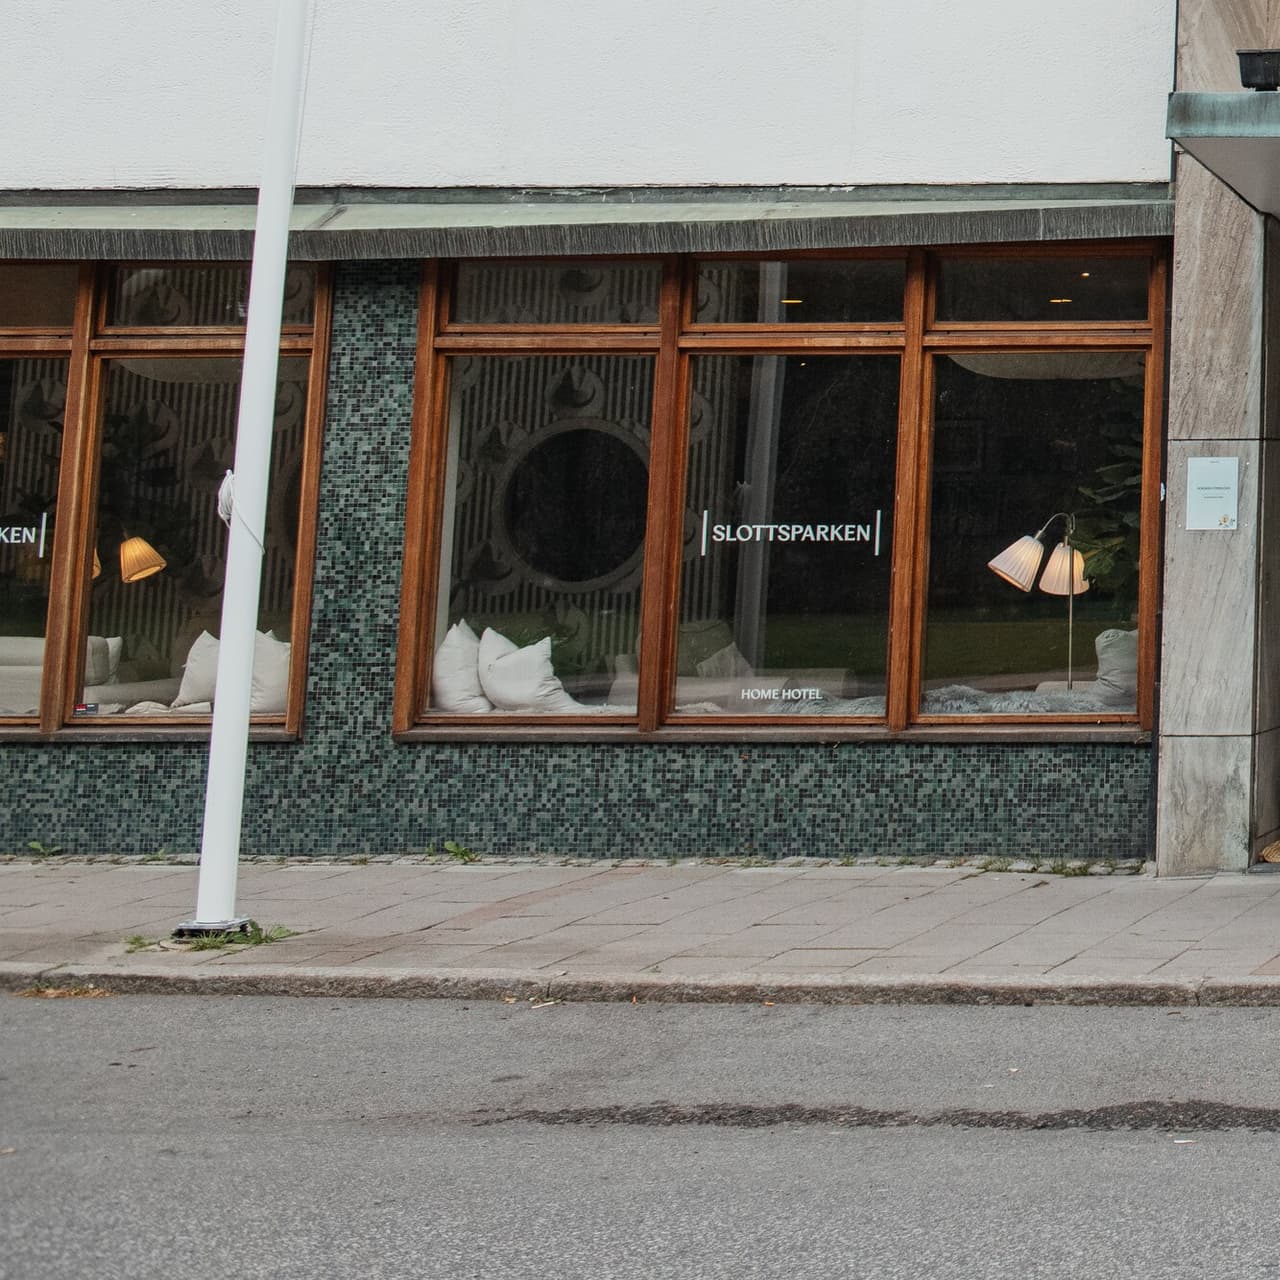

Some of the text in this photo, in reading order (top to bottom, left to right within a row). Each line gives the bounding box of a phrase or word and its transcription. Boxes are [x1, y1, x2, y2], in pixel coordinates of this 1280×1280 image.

[712, 524, 871, 542] SLOTTSPARKEN
[741, 688, 823, 700] HOME HOTEL
